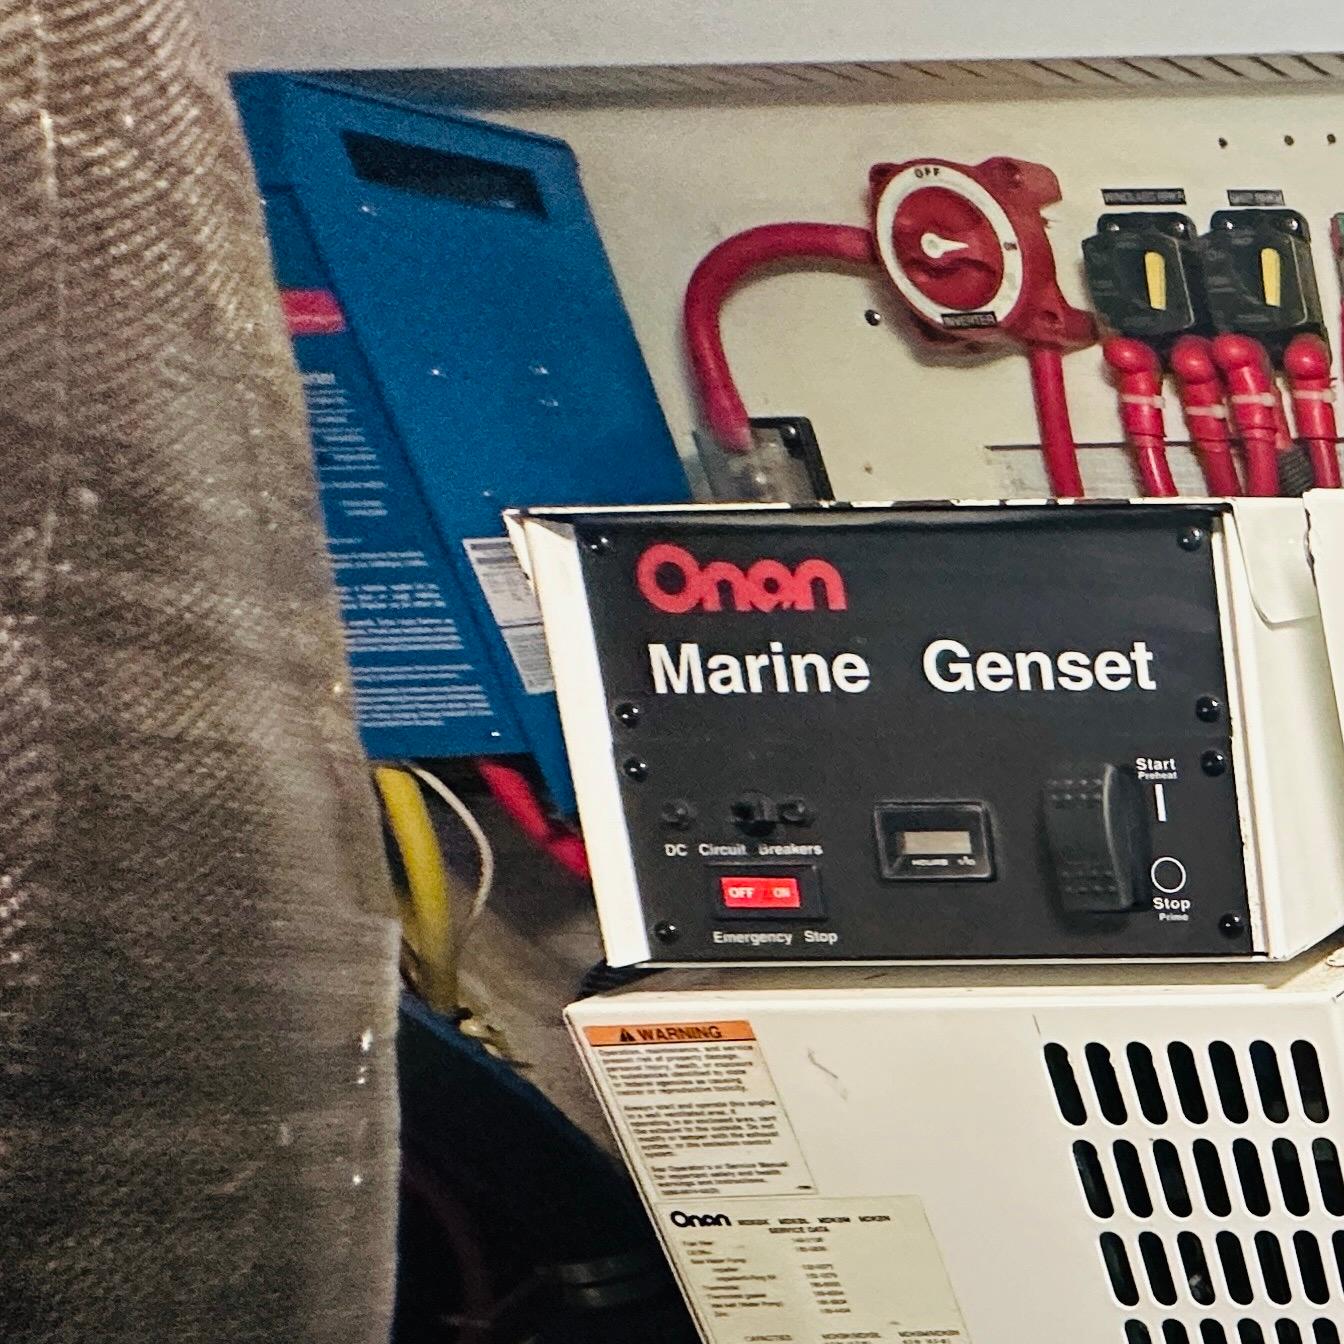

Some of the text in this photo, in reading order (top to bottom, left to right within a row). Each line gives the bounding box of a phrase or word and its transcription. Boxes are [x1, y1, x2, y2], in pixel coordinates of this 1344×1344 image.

[914, 167, 940, 178] OFF
[636, 541, 848, 614] Onan
[647, 638, 1157, 695] Marine Genset
[1135, 757, 1176, 771] Start
[664, 843, 823, 857] DC Circuit Breakers
[728, 887, 755, 898] OFF
[1153, 897, 1191, 913] Stop
[712, 930, 838, 946] Emergency Stop
[637, 1026, 722, 1041] WARNING
[670, 1210, 731, 1230] Onan
